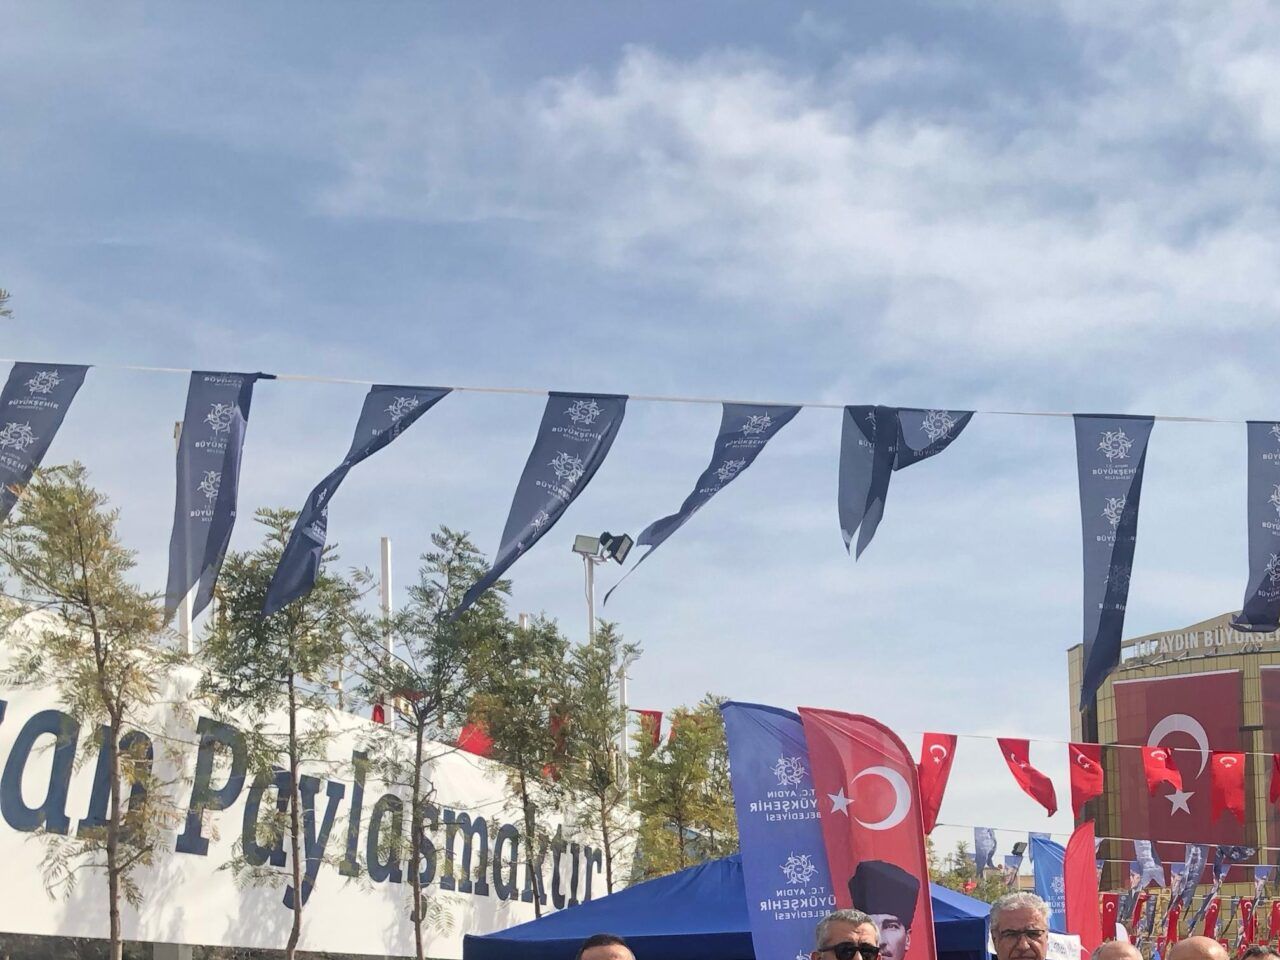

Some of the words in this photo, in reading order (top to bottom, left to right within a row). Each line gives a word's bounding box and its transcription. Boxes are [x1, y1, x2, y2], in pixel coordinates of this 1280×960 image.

[1092, 467, 1137, 477] BÜYÜKŞEHİ
[1160, 632, 1199, 653] AYDIN
[0, 700, 153, 840] an
